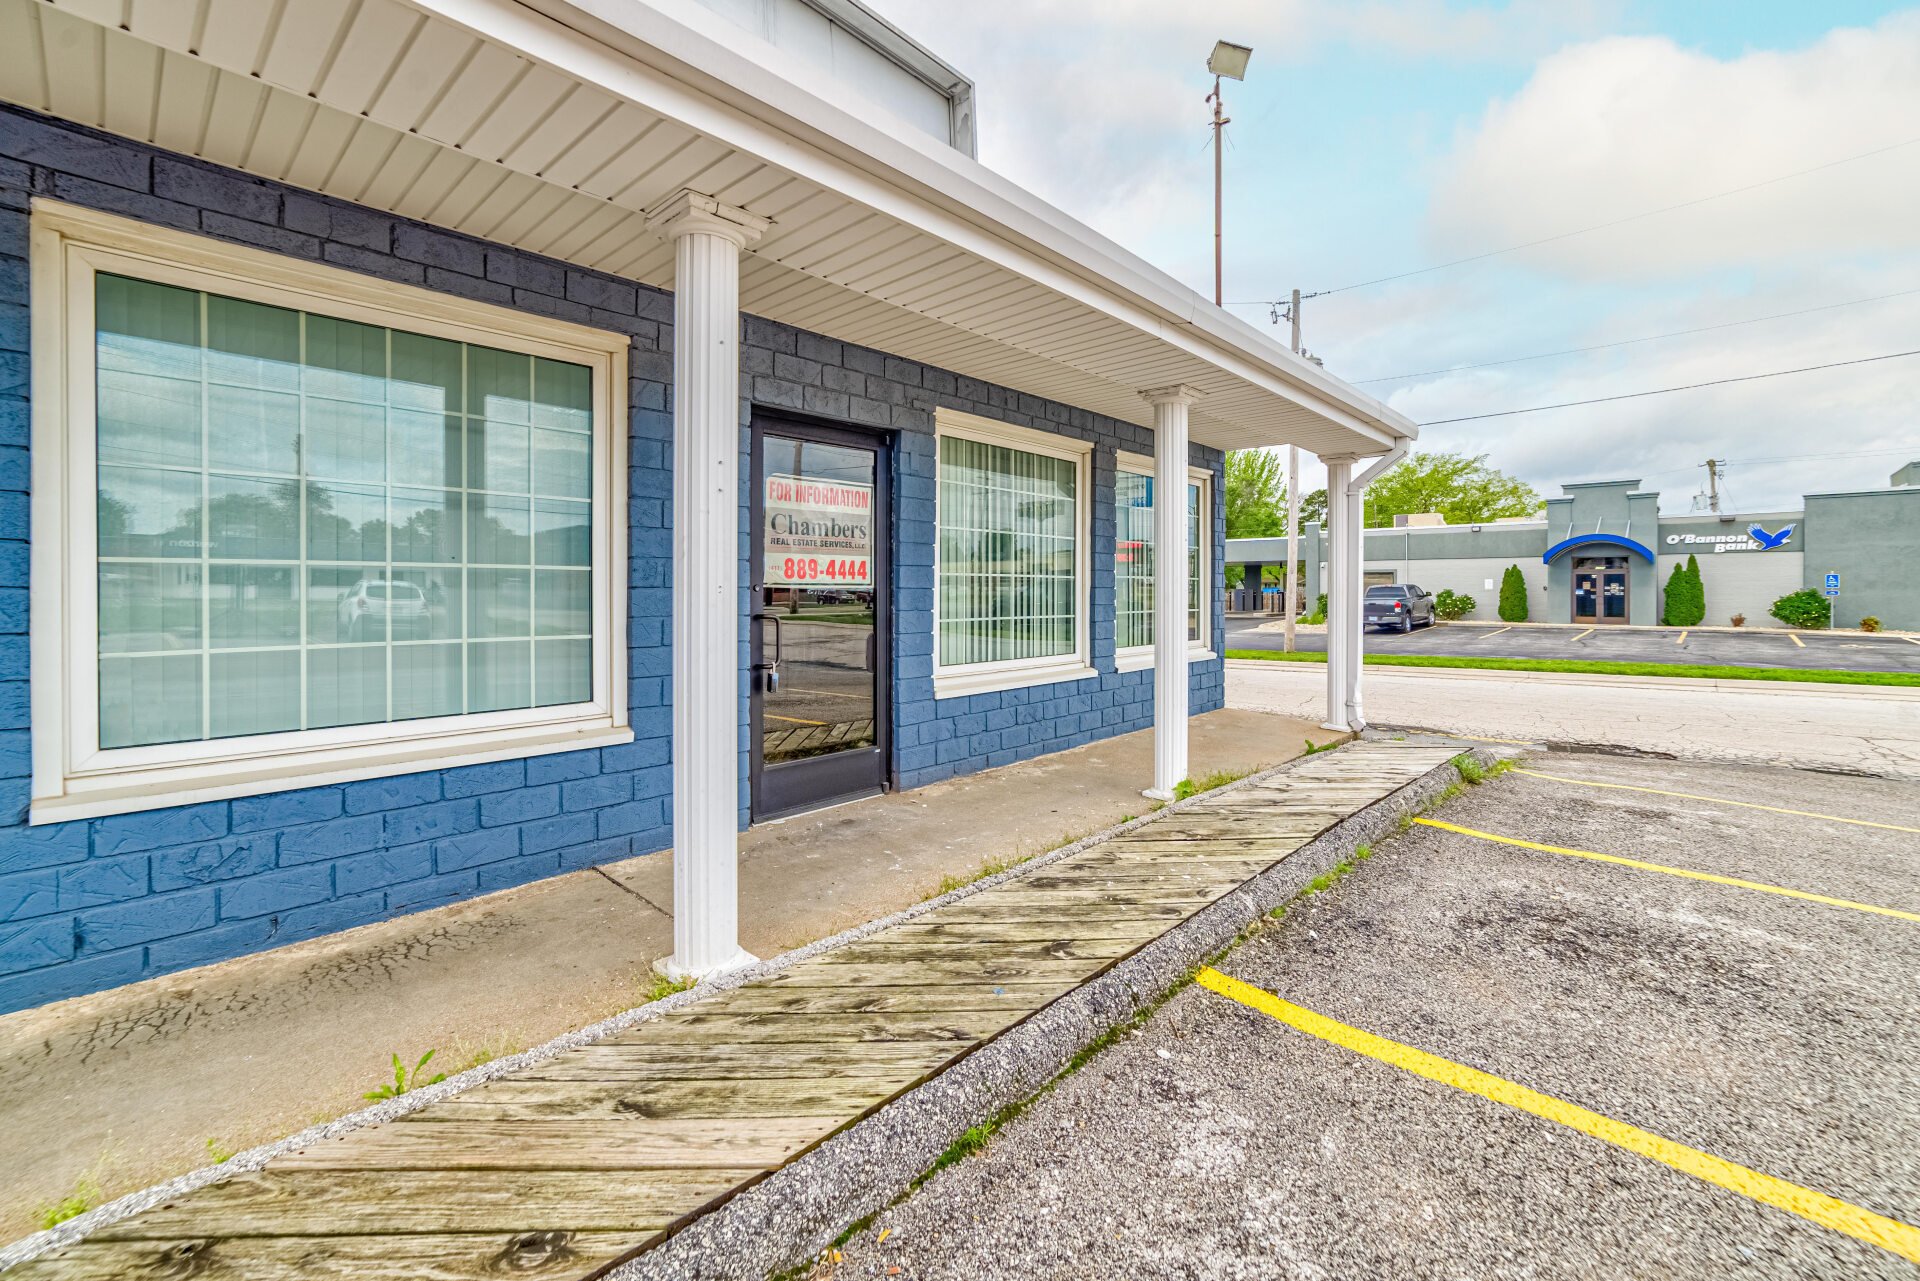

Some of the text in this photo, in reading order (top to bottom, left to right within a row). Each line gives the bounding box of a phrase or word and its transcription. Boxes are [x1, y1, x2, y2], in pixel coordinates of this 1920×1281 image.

[769, 480, 869, 508] FOR INFORMATION
[771, 513, 867, 539] Chambers
[770, 537, 790, 546] REAL
[793, 539, 818, 547] ESTATE
[1666, 534, 1748, 545] O'Bannon
[1714, 540, 1760, 553] Bank
[784, 558, 868, 580] 889-4444
